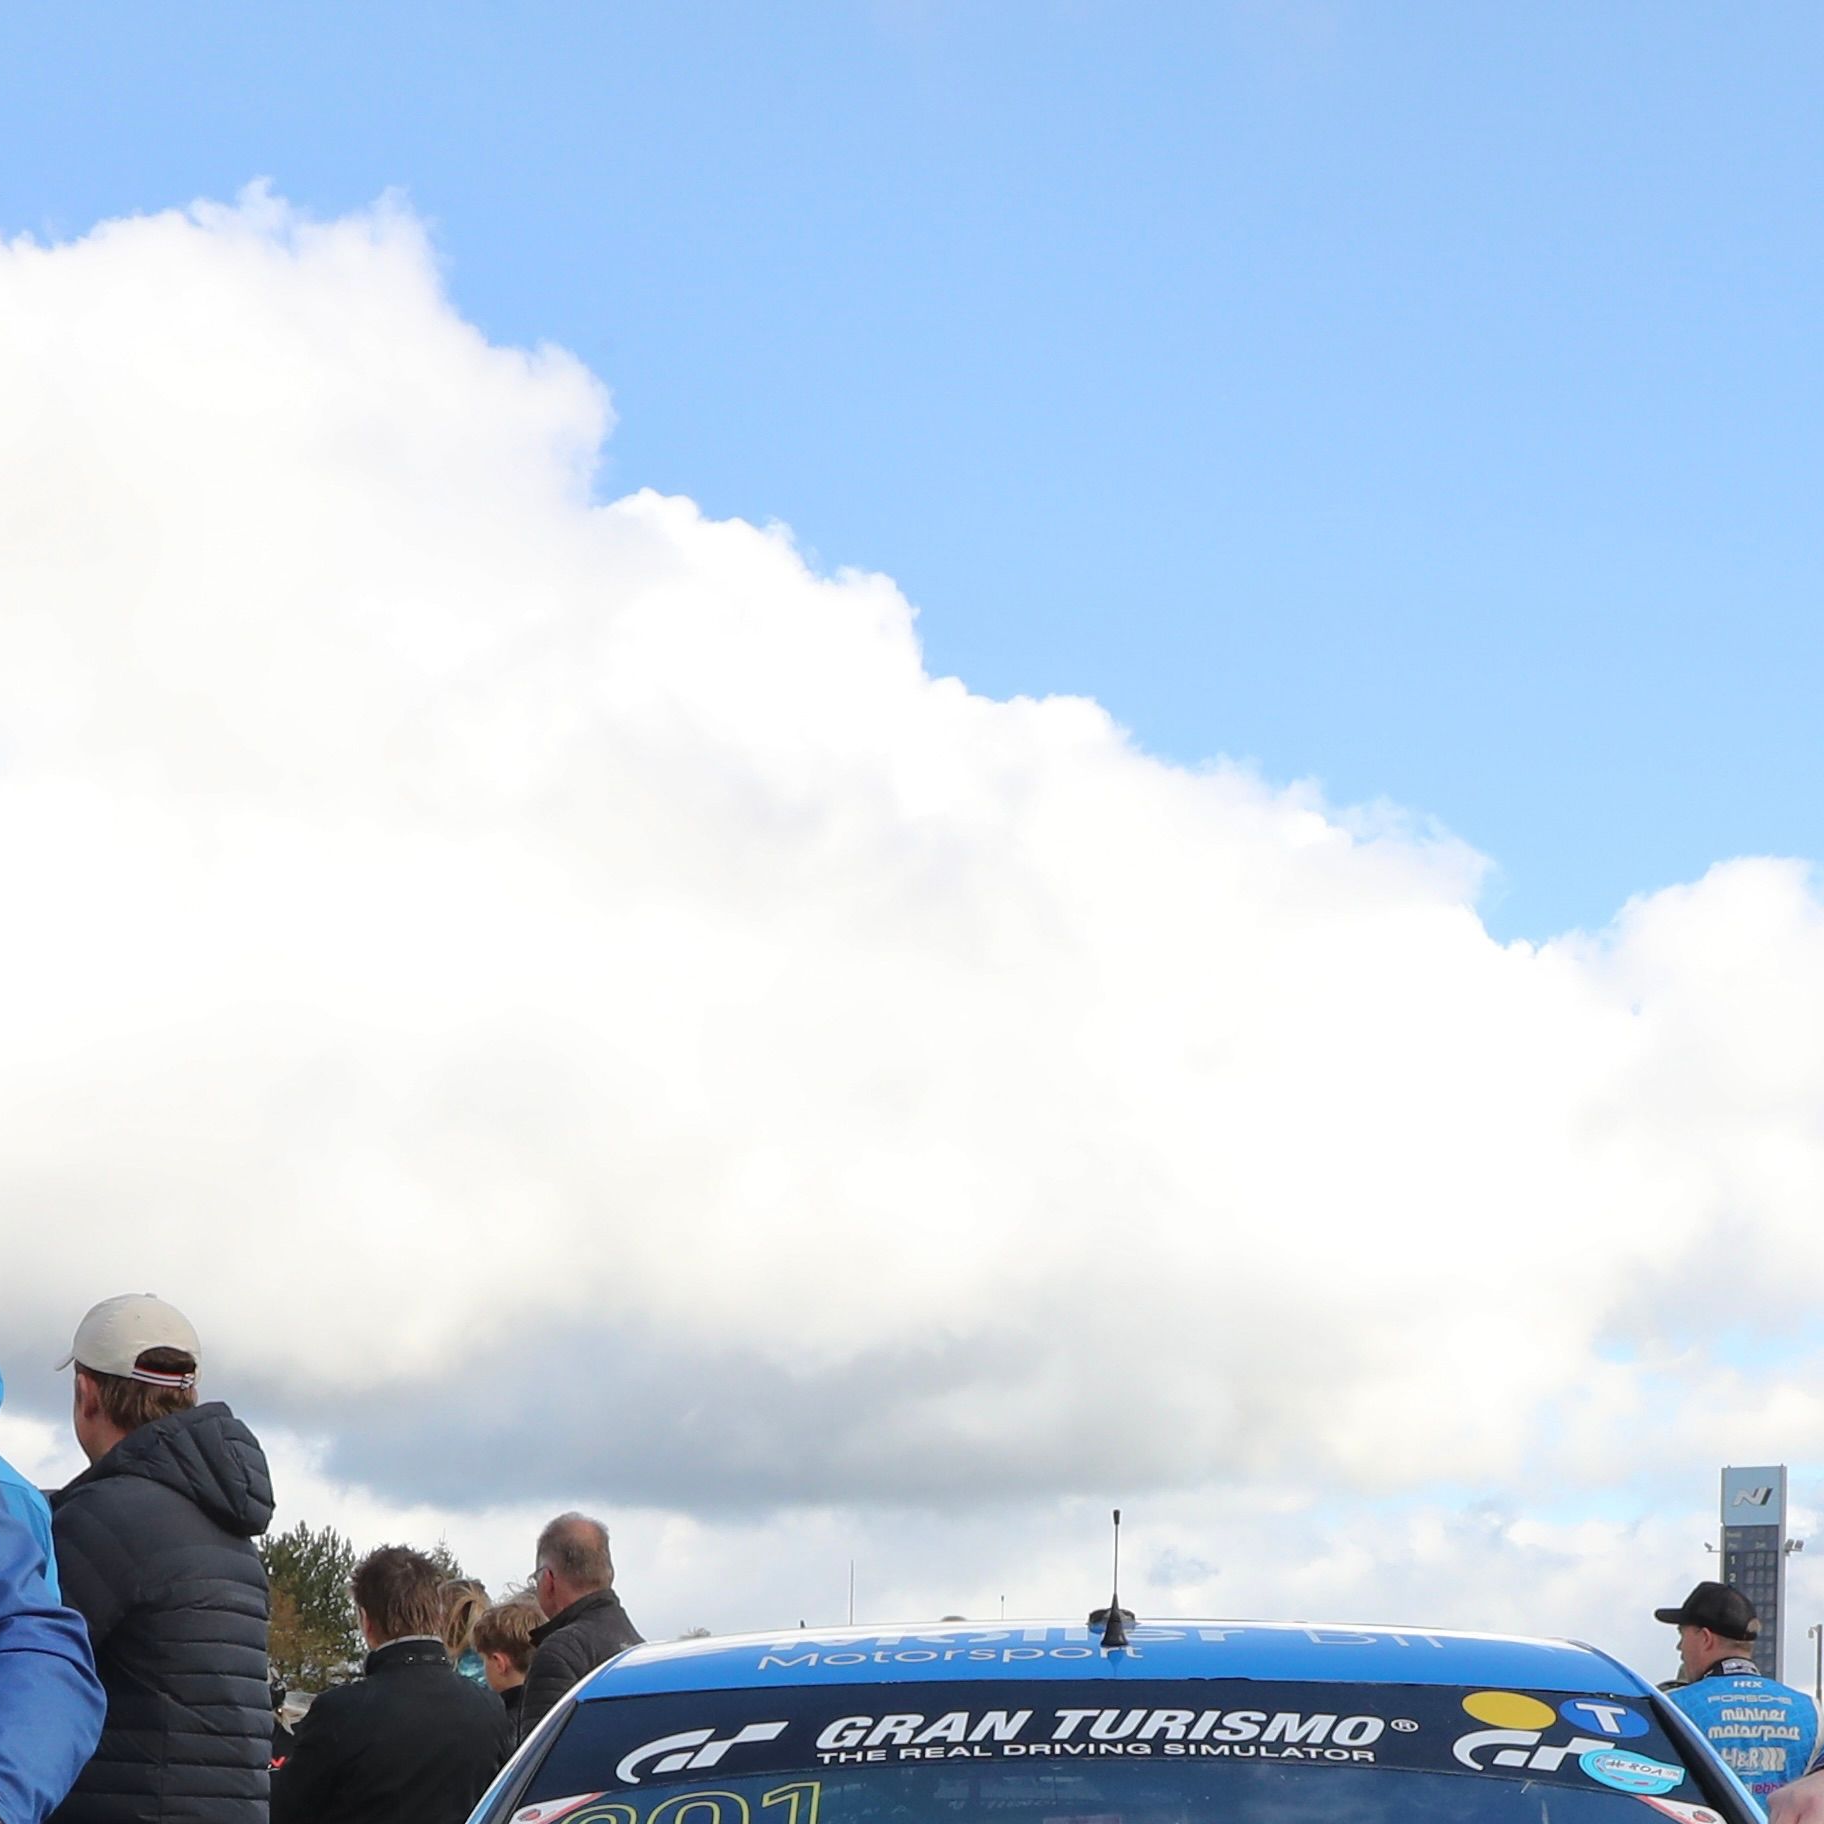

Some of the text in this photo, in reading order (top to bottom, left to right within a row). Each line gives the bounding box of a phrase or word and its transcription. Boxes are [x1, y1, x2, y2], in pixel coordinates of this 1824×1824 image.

[757, 1646, 1144, 1671] Motorsport
[816, 1710, 1033, 1750] GRAN
[1707, 1725, 1801, 1741] motorsport
[817, 1743, 1376, 1766] THE REAL DRIVING SIMULATOR
